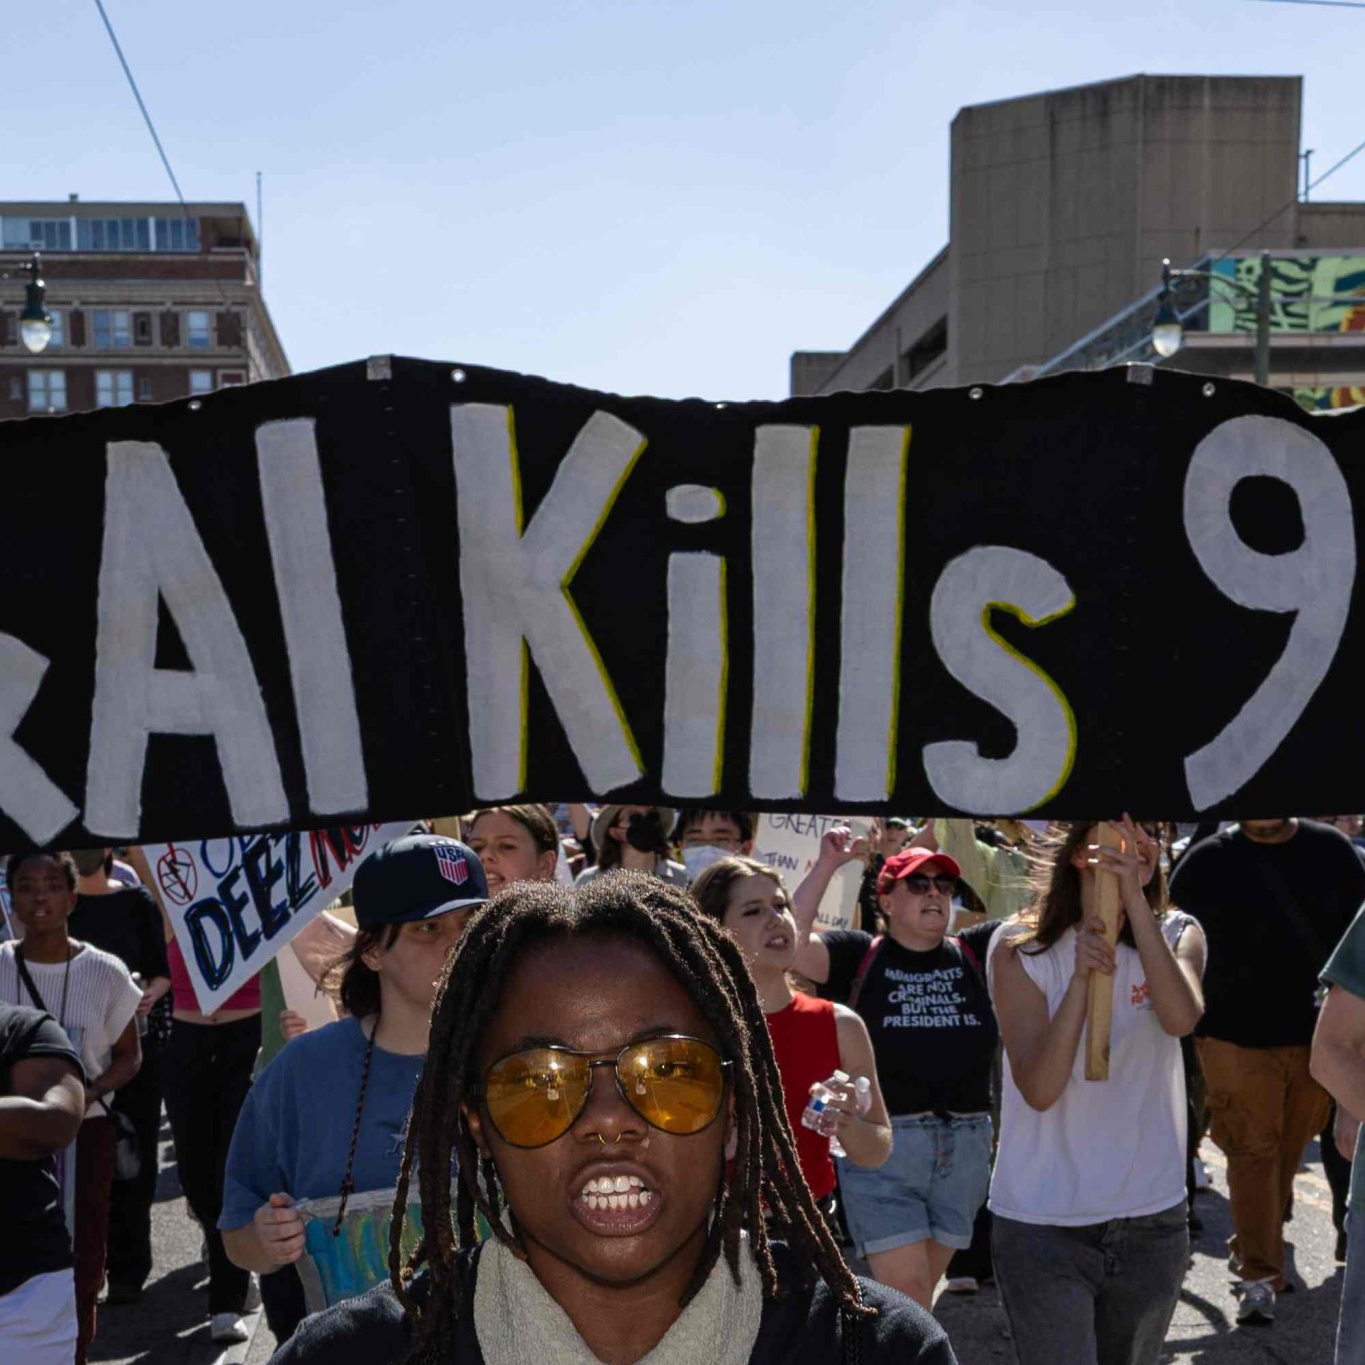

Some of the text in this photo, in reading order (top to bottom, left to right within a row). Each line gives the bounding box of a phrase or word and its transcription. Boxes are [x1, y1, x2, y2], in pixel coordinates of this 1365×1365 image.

[450, 402, 1076, 816] Kills
[435, 847, 465, 861] USA
[764, 852, 799, 870] THAN
[885, 967, 963, 983] IMMIGRANTS
[898, 981, 953, 995] ARE NOT
[901, 1003, 958, 1015] BUT THE
[883, 1014, 981, 1028] PRESIDENT IS.
